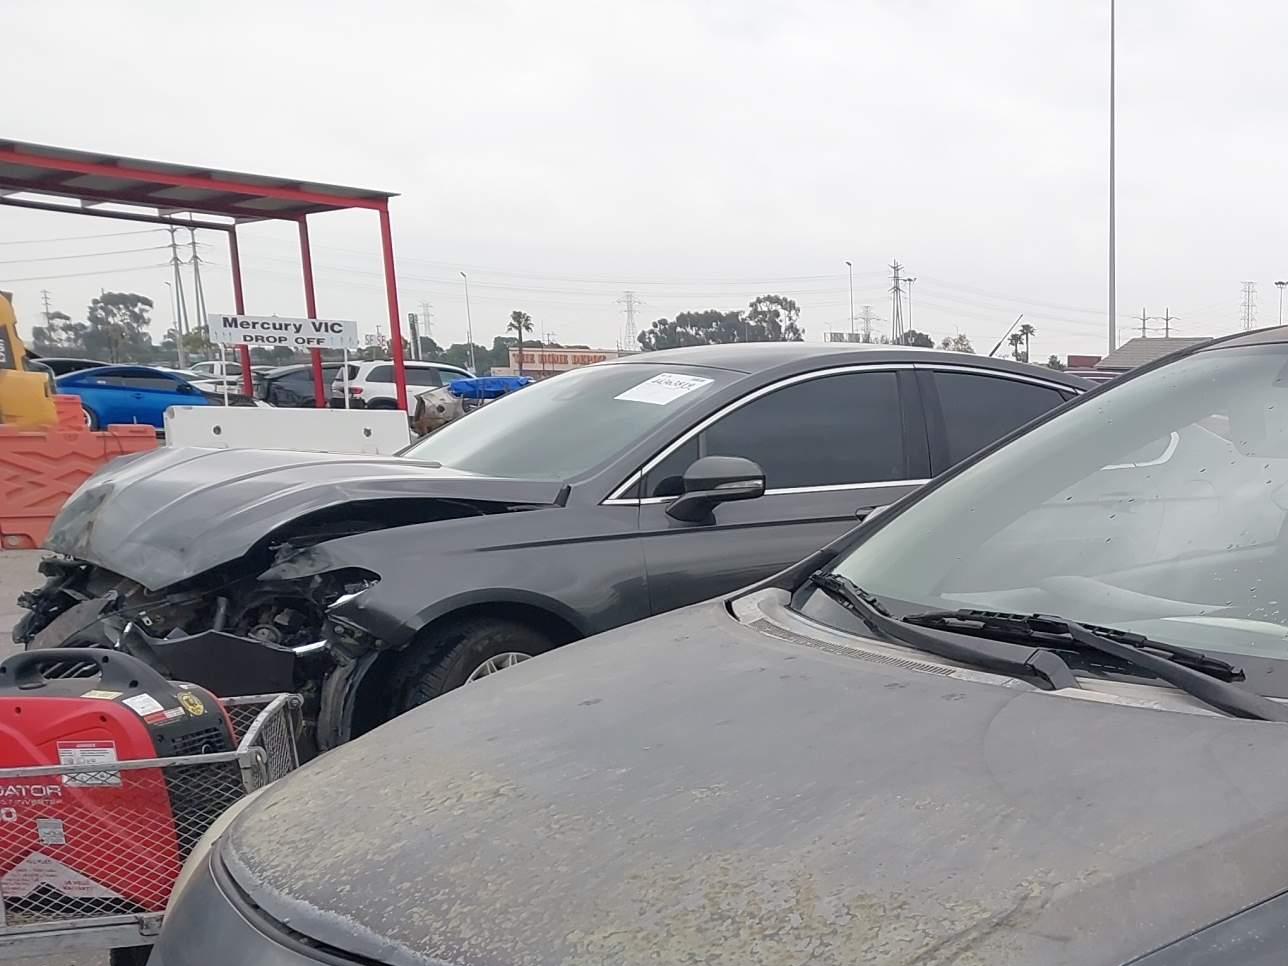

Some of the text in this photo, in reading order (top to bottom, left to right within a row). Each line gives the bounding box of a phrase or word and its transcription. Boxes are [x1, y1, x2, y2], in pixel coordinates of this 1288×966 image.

[222, 316, 344, 334] Mercury VIC
[242, 334, 326, 346] DROP OFF
